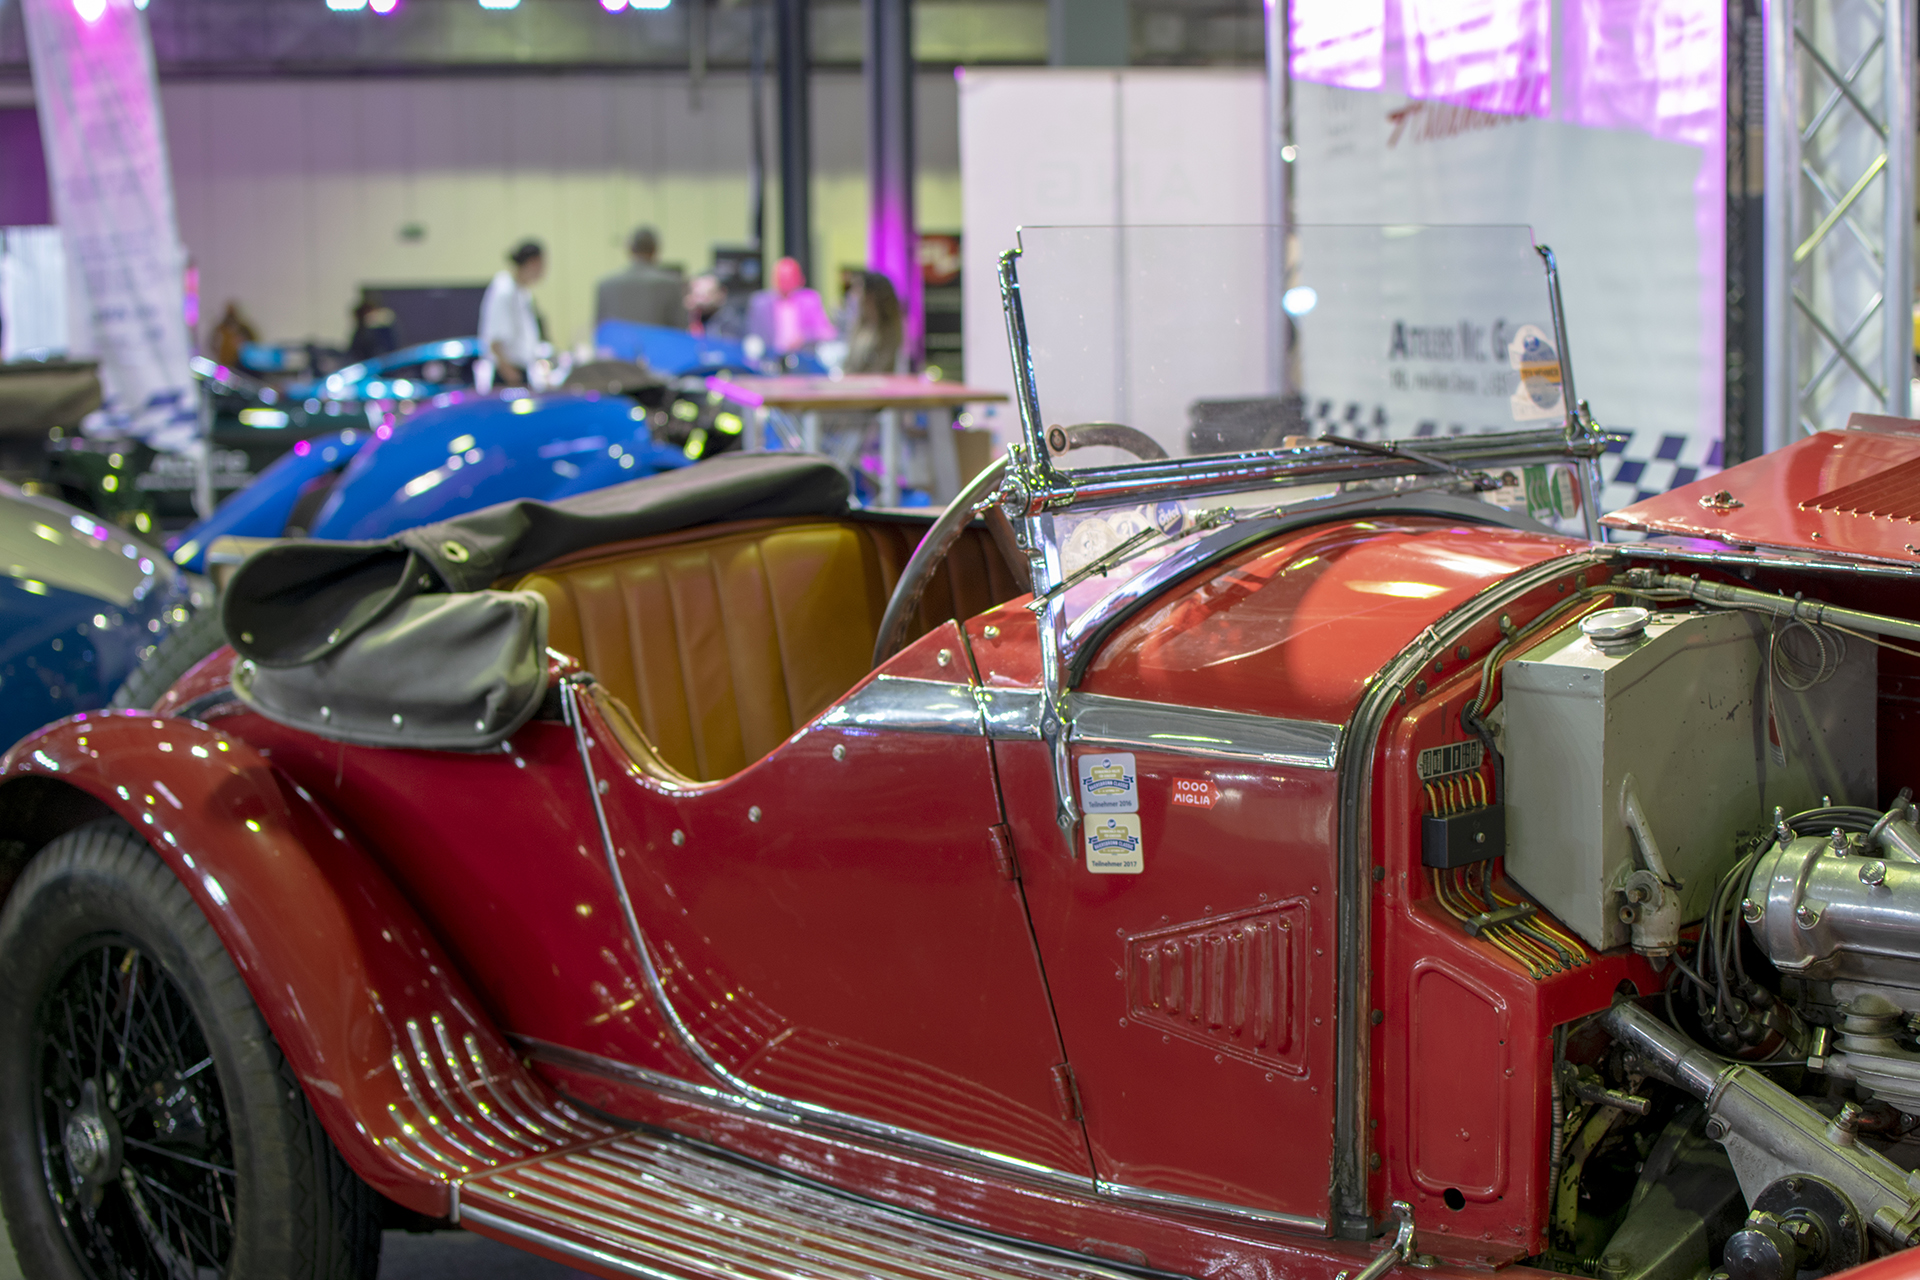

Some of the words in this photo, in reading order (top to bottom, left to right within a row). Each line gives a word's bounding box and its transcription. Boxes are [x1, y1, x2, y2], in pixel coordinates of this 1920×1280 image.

[1177, 780, 1208, 793] 1000
[1089, 800, 1118, 808] Teilnehmer
[1119, 800, 1132, 808] 2016
[1174, 793, 1210, 806] MIGLIA
[1092, 860, 1122, 868] Teilnehmer
[1123, 860, 1137, 868] 2017
